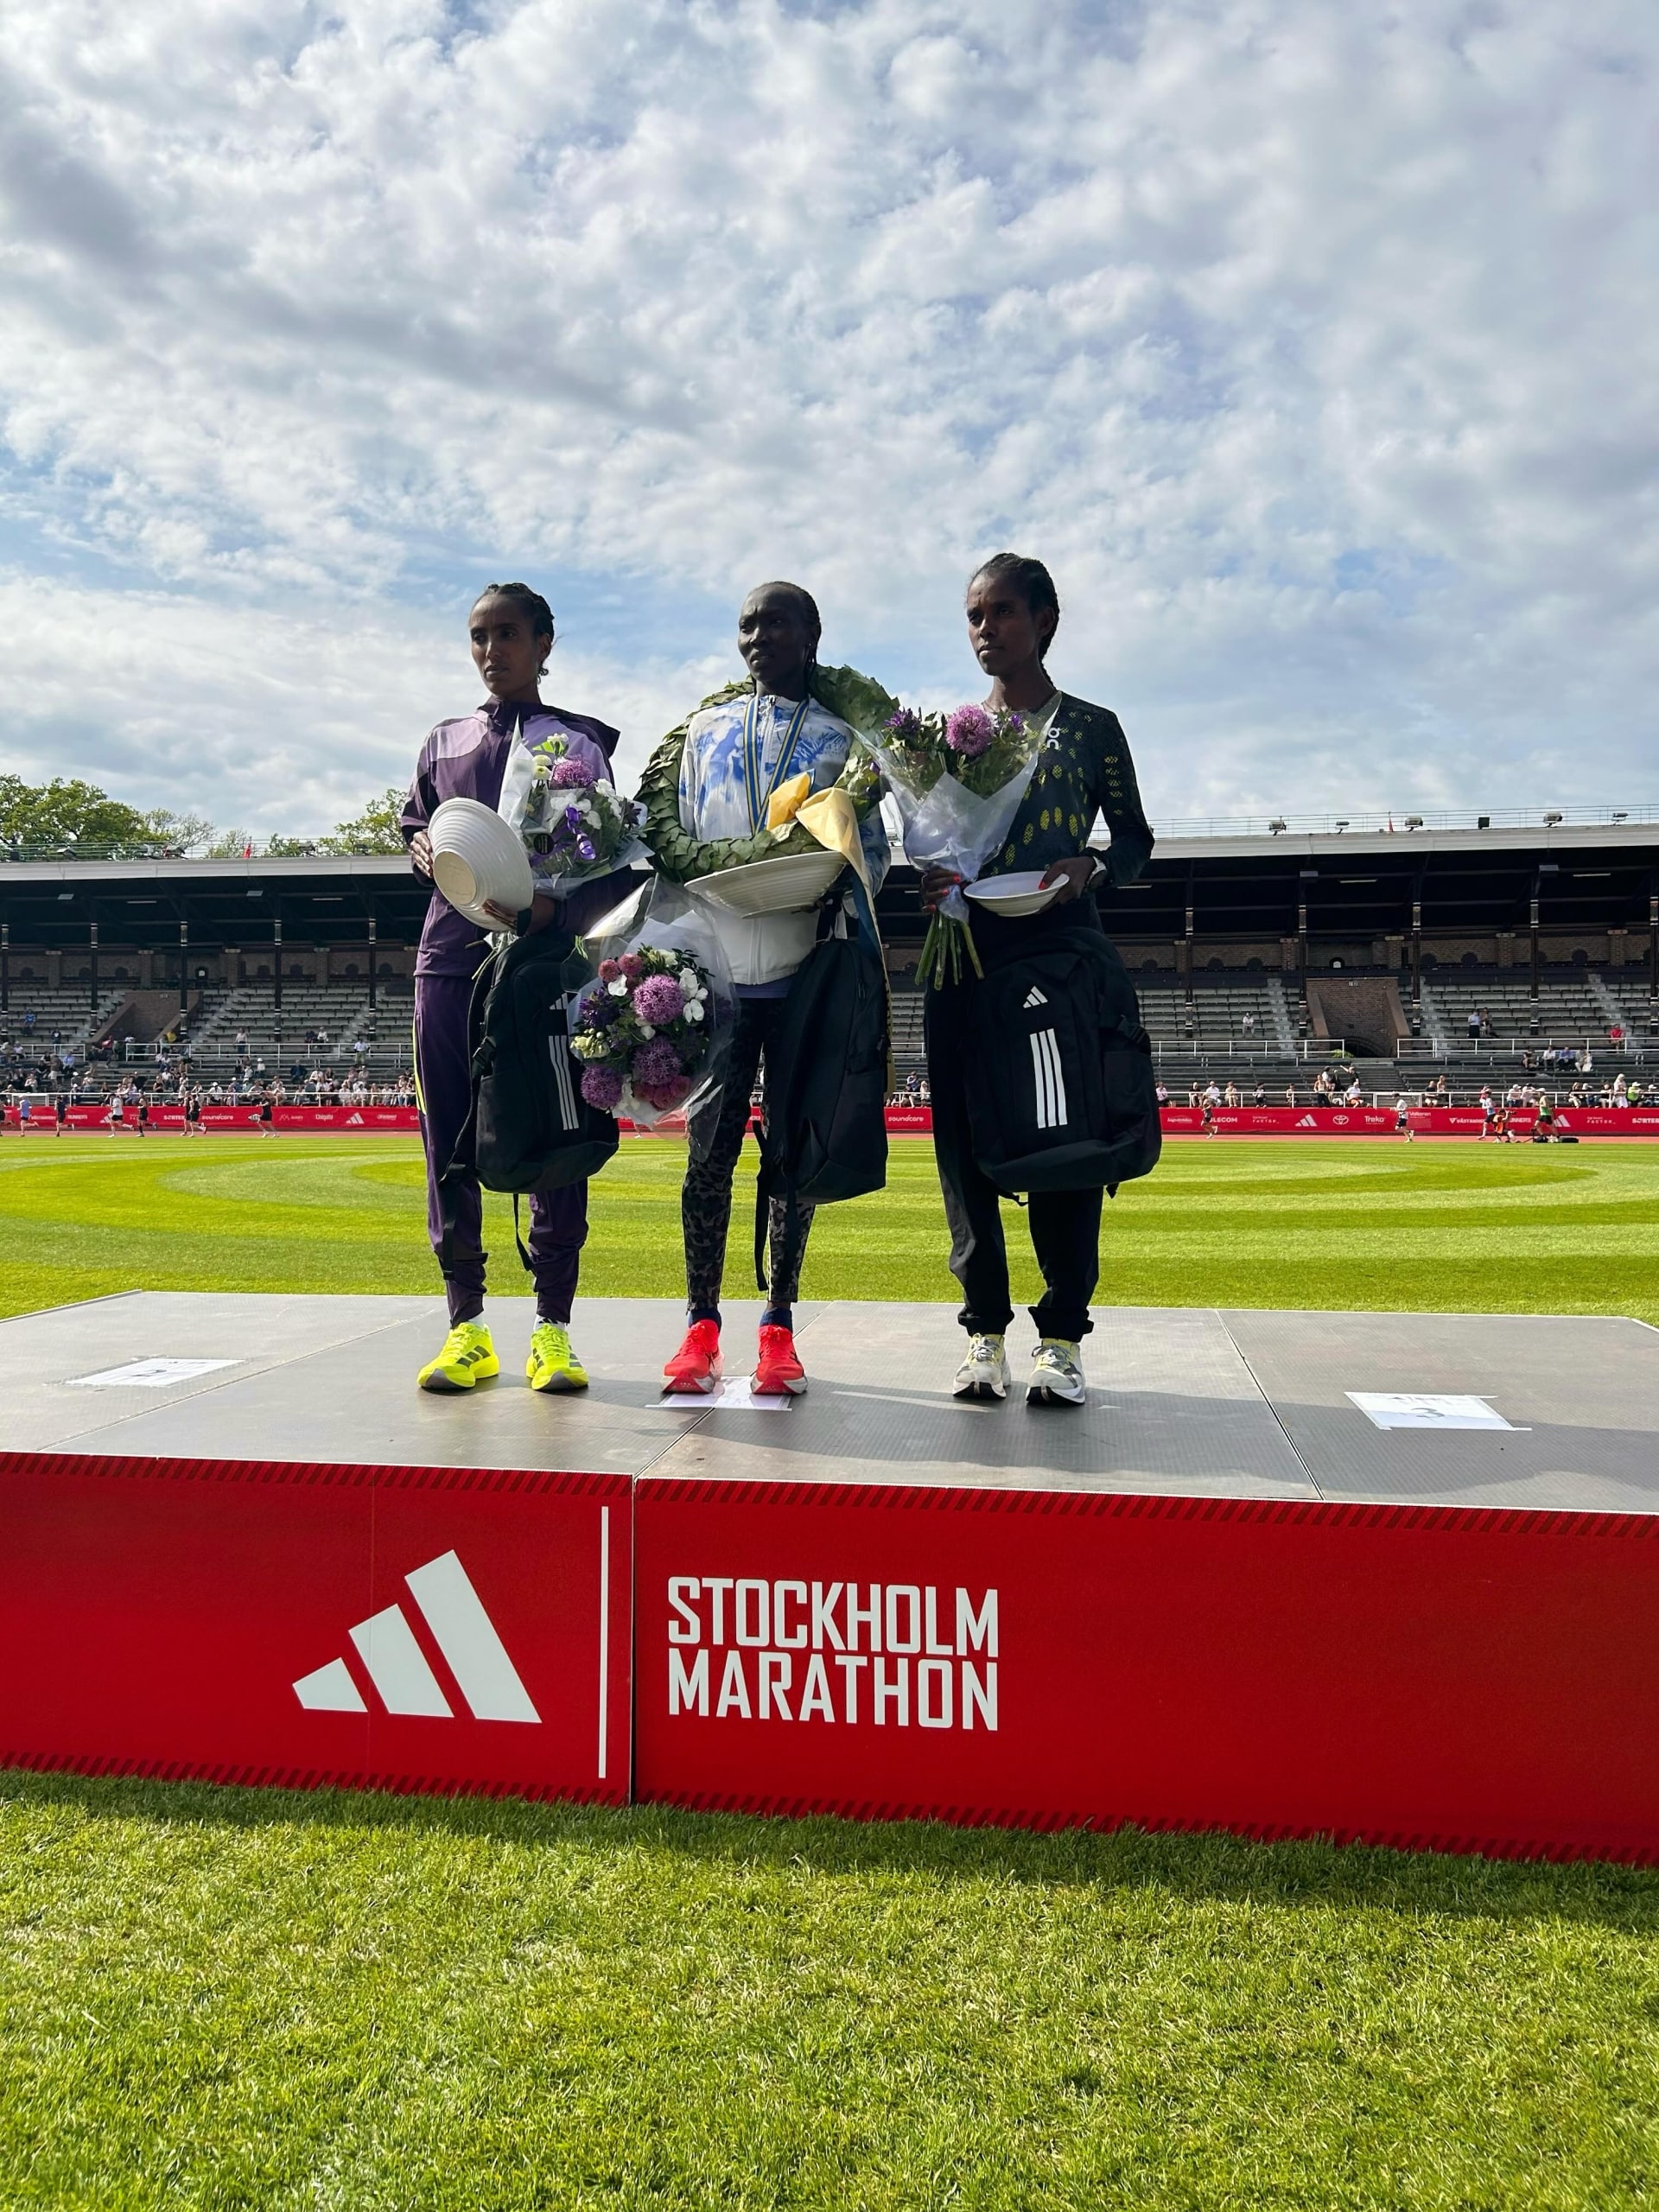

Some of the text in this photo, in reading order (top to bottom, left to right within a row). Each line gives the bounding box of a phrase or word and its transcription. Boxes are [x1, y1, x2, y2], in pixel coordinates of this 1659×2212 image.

[1411, 1408, 1446, 1419] 3
[668, 1576, 999, 1658] STOCKHOLM
[668, 1647, 998, 1732] MARATHON
